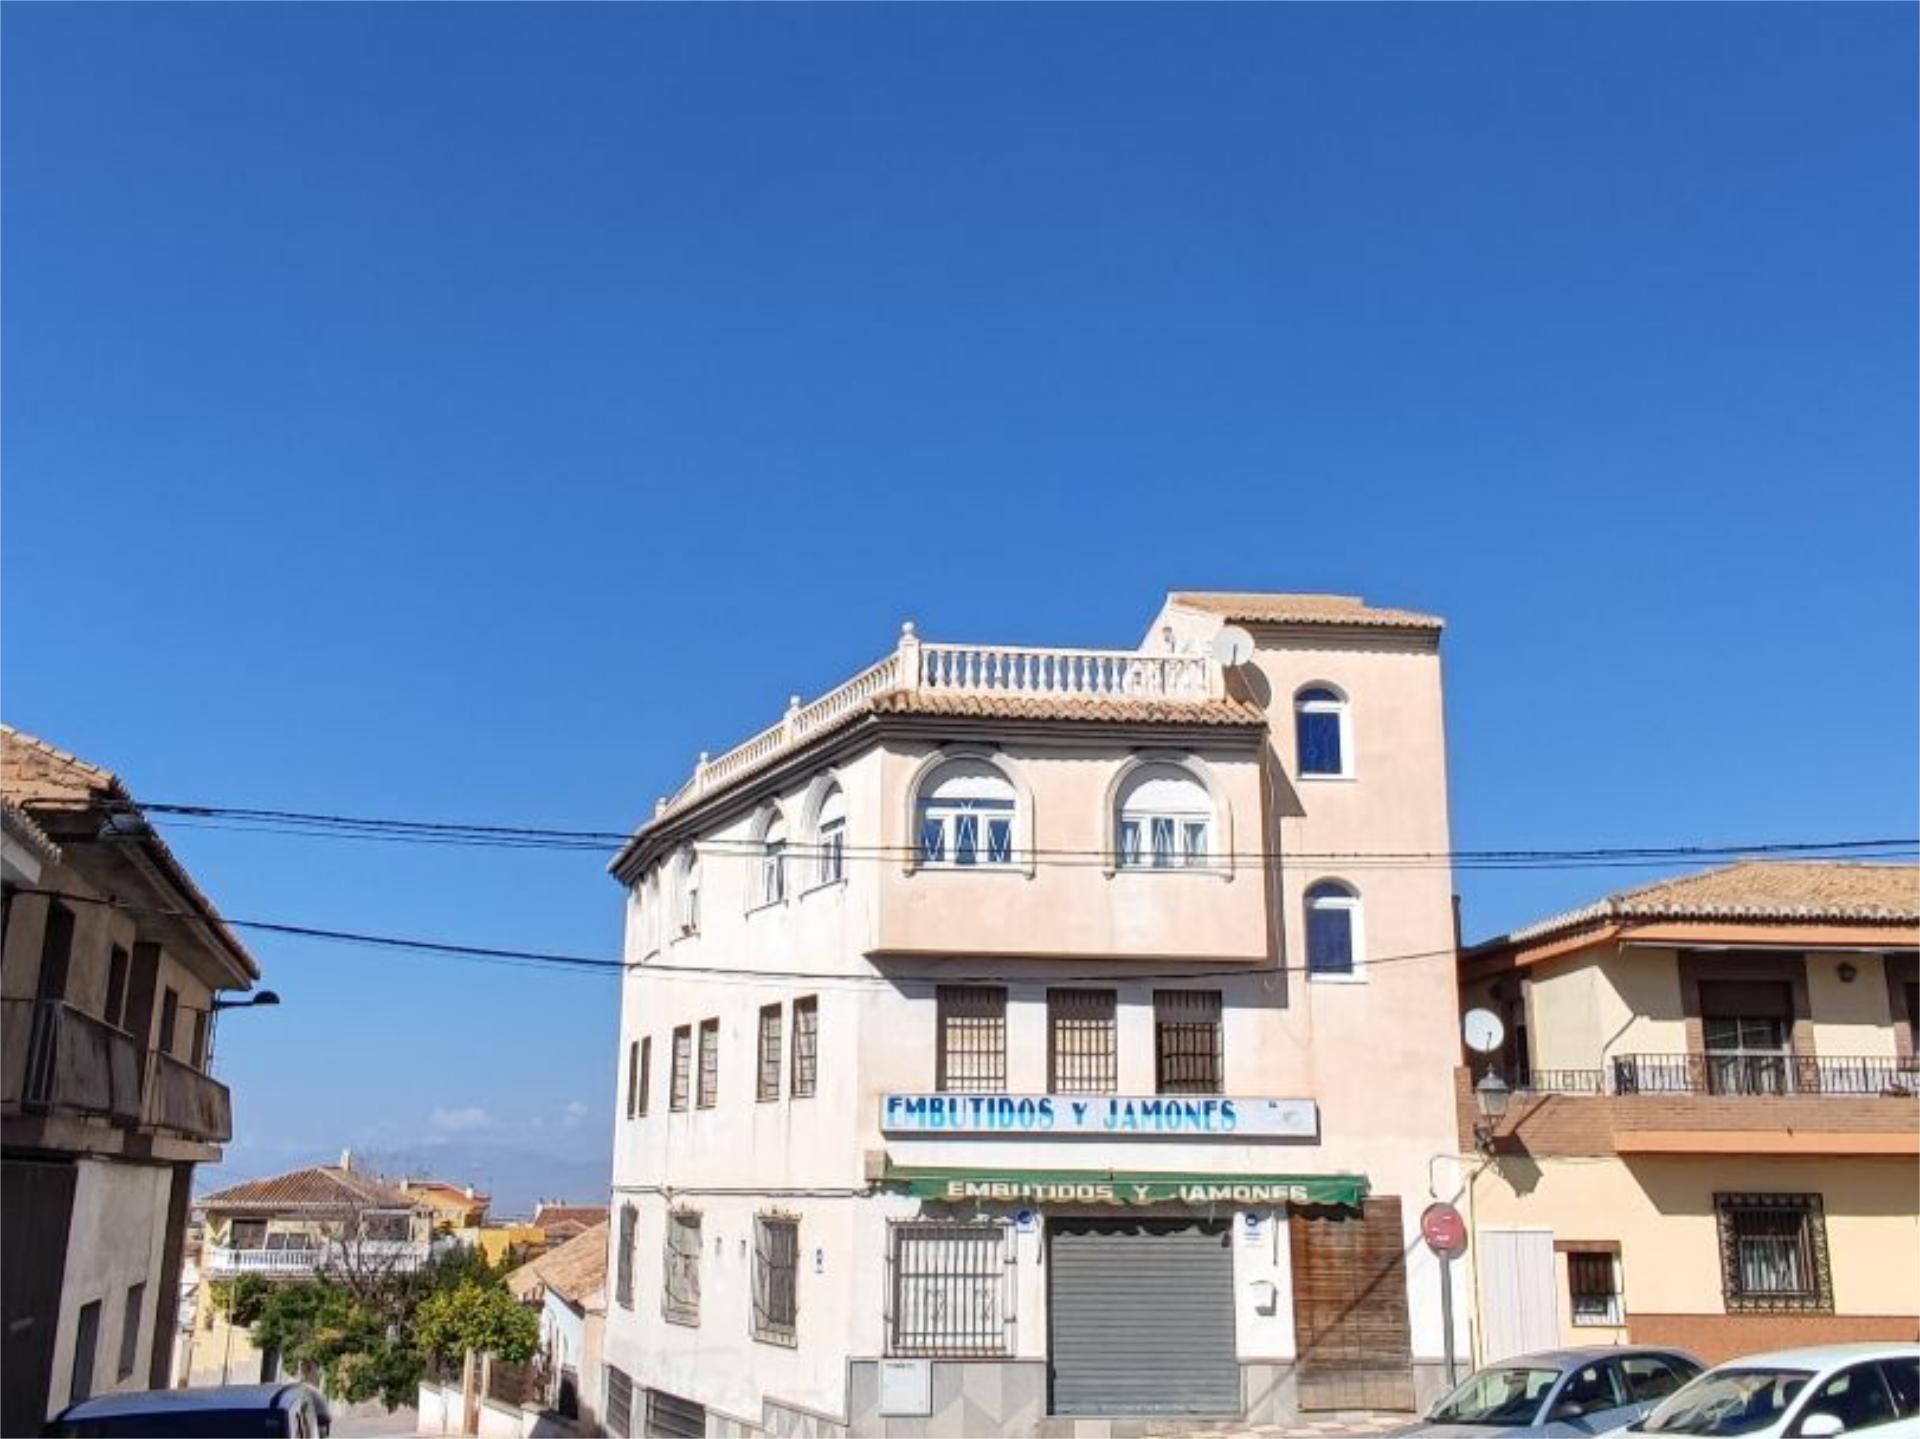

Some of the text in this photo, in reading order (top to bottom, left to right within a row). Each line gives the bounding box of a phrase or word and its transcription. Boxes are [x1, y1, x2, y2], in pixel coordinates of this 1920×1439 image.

[887, 1096, 1237, 1132] EMBUTIDOS Y JAMONES
[947, 1181, 1308, 1201] EMBUTIDOS Y JAMONES
